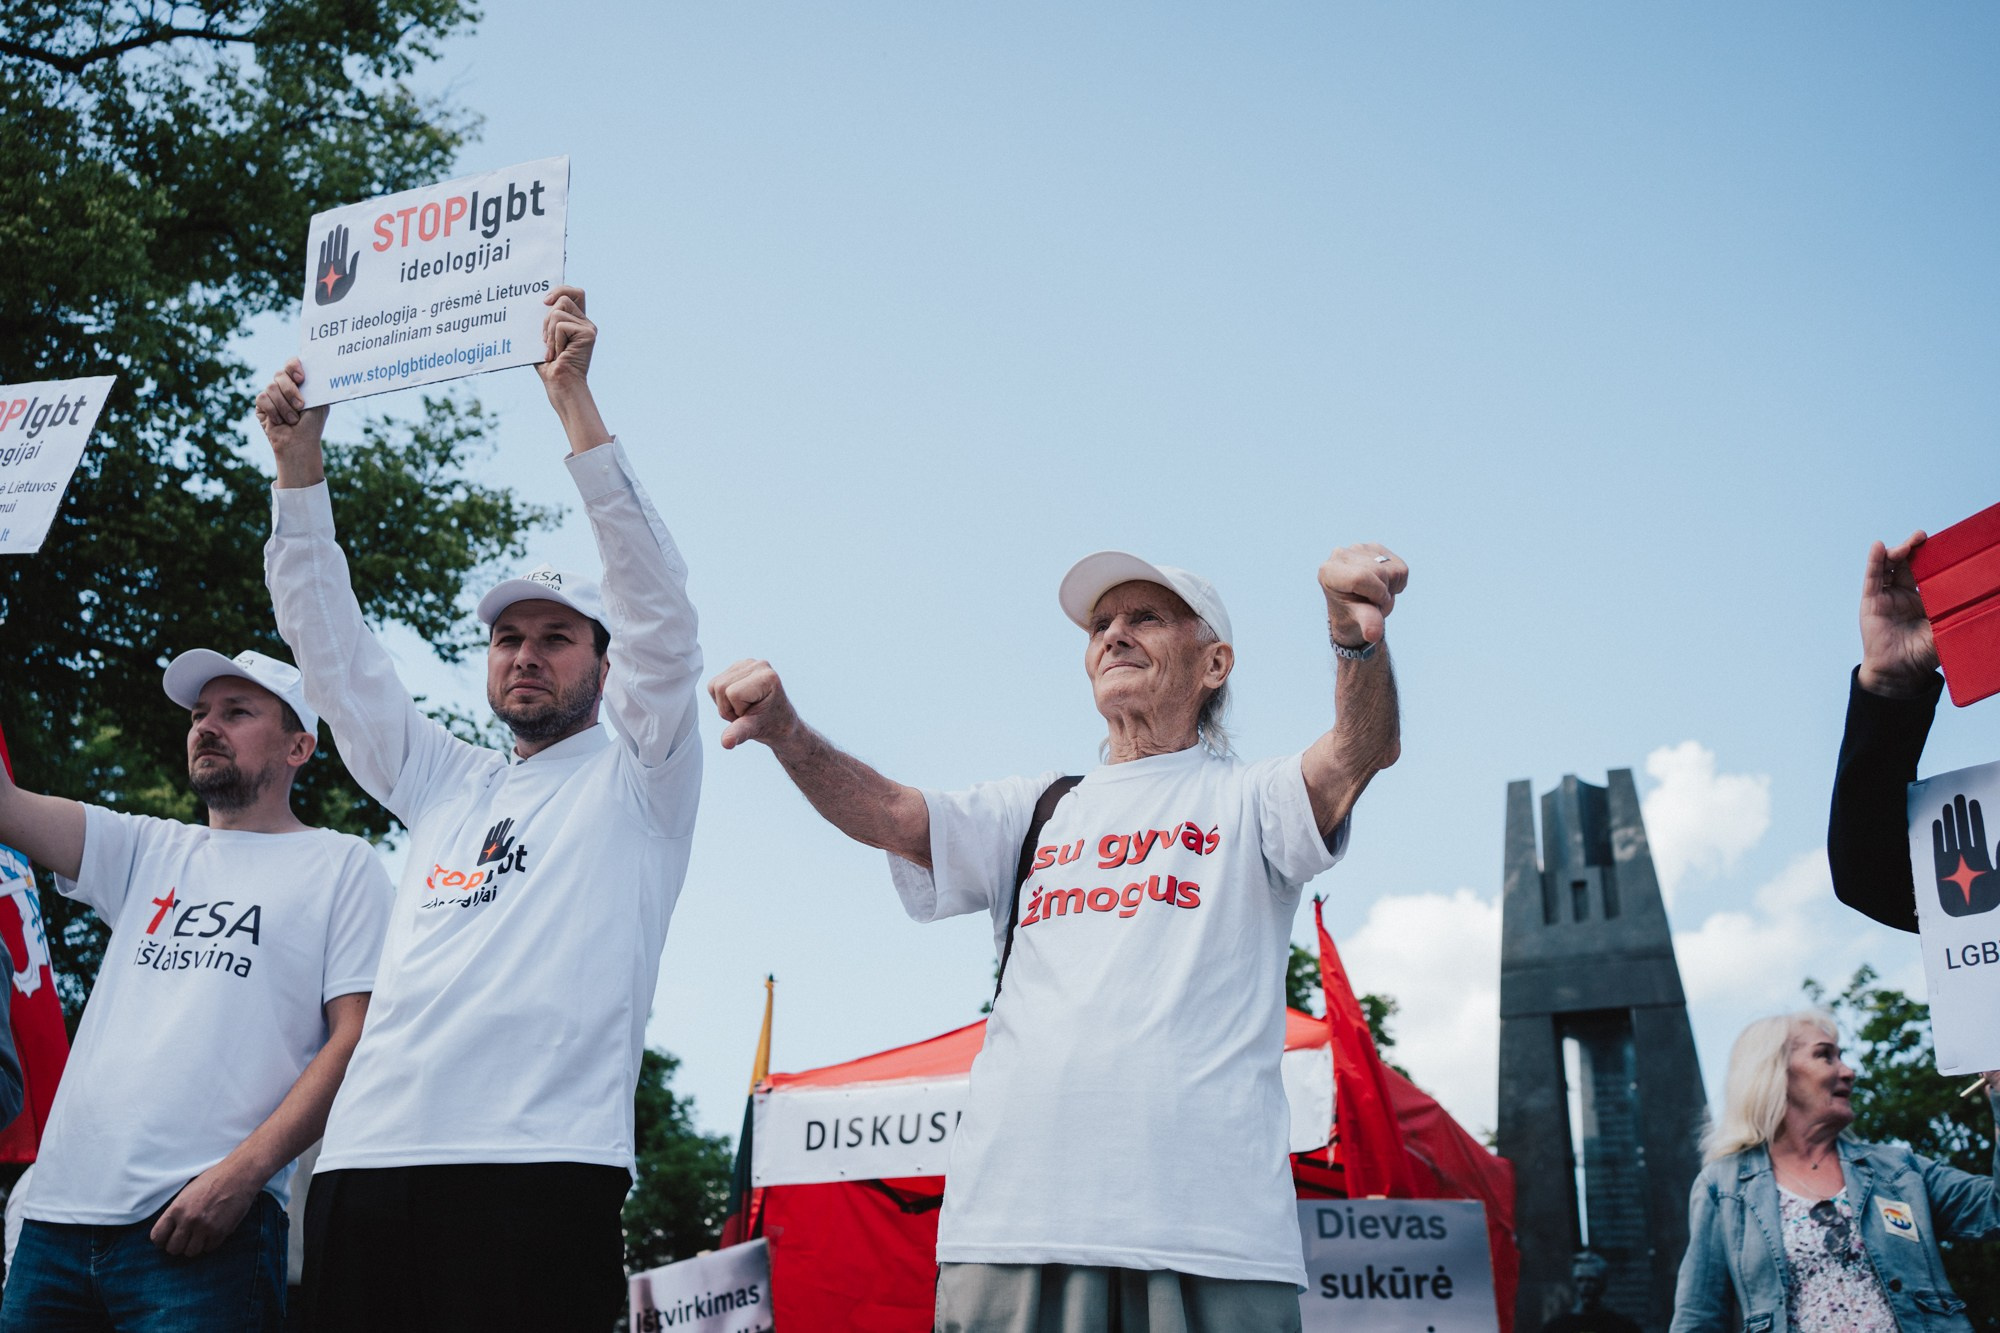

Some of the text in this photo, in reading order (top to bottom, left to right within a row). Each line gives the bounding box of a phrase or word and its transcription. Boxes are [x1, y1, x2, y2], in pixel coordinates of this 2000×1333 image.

[400, 239, 511, 283] ideologijai
[310, 318, 348, 341] LGBT
[351, 306, 418, 332] ideologija
[430, 290, 482, 317] grėsmė
[486, 279, 550, 303] Lietuvos
[337, 307, 507, 356] nacionaliniam saugumui
[329, 338, 512, 390] www.stoplgbtideologijai.lt
[7, 481, 57, 495] Lietuvos
[1027, 821, 1221, 880] su gyvas
[1020, 875, 1202, 928] žmogus
[133, 940, 253, 978] išlaisvina
[1945, 940, 2000, 970] LGB
[1316, 1207, 1448, 1241] Dievas
[1320, 1264, 1454, 1300] sukūrė
